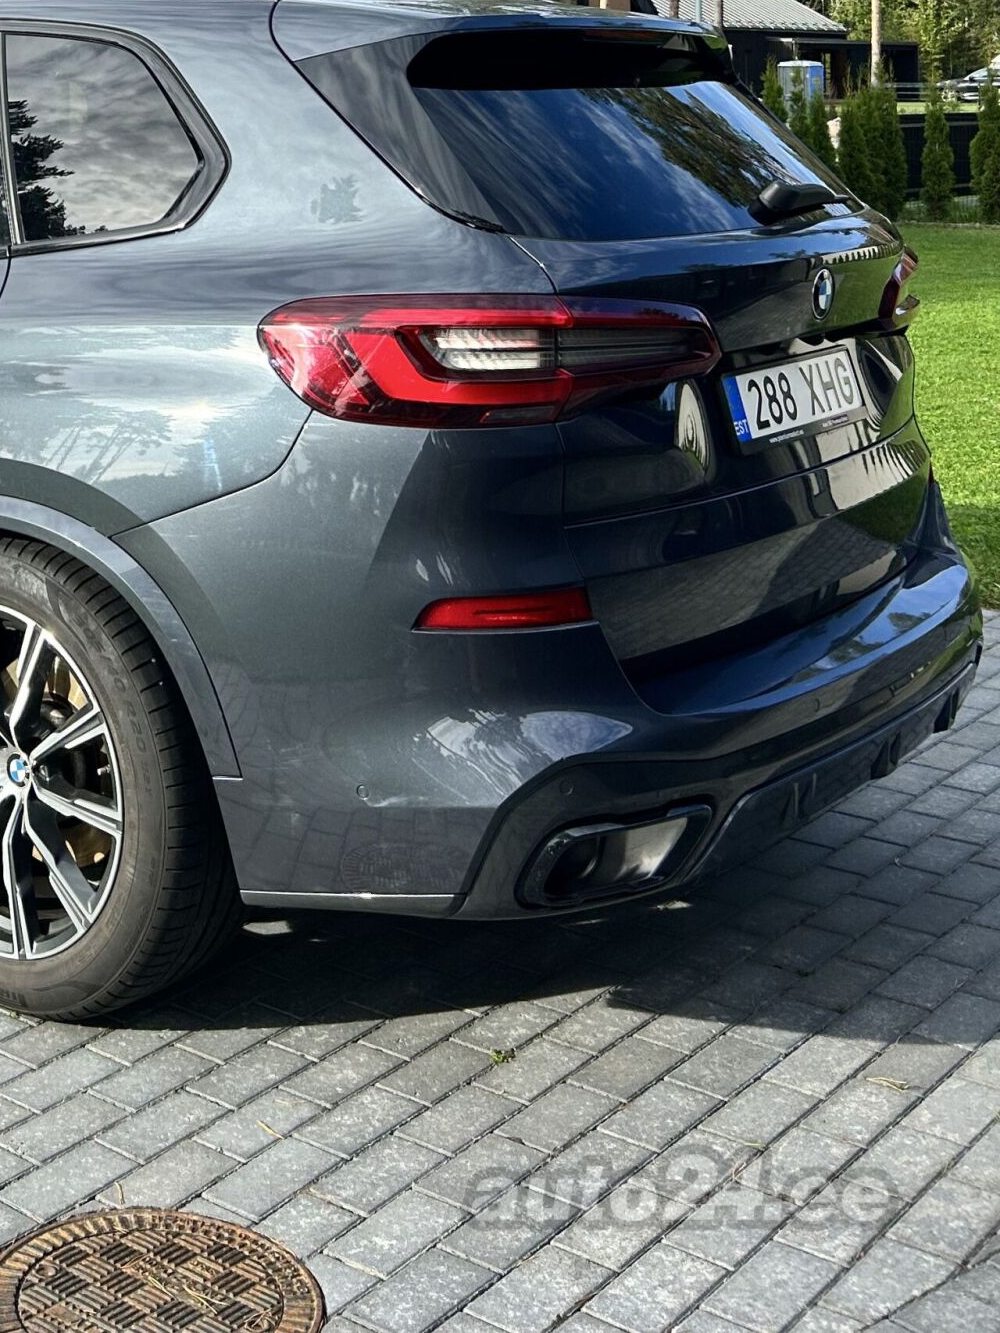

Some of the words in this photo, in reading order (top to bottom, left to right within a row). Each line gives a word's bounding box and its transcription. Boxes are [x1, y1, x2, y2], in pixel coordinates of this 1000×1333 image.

[747, 372, 797, 430] 288
[799, 357, 854, 416] XHG
[733, 419, 749, 435] EST
